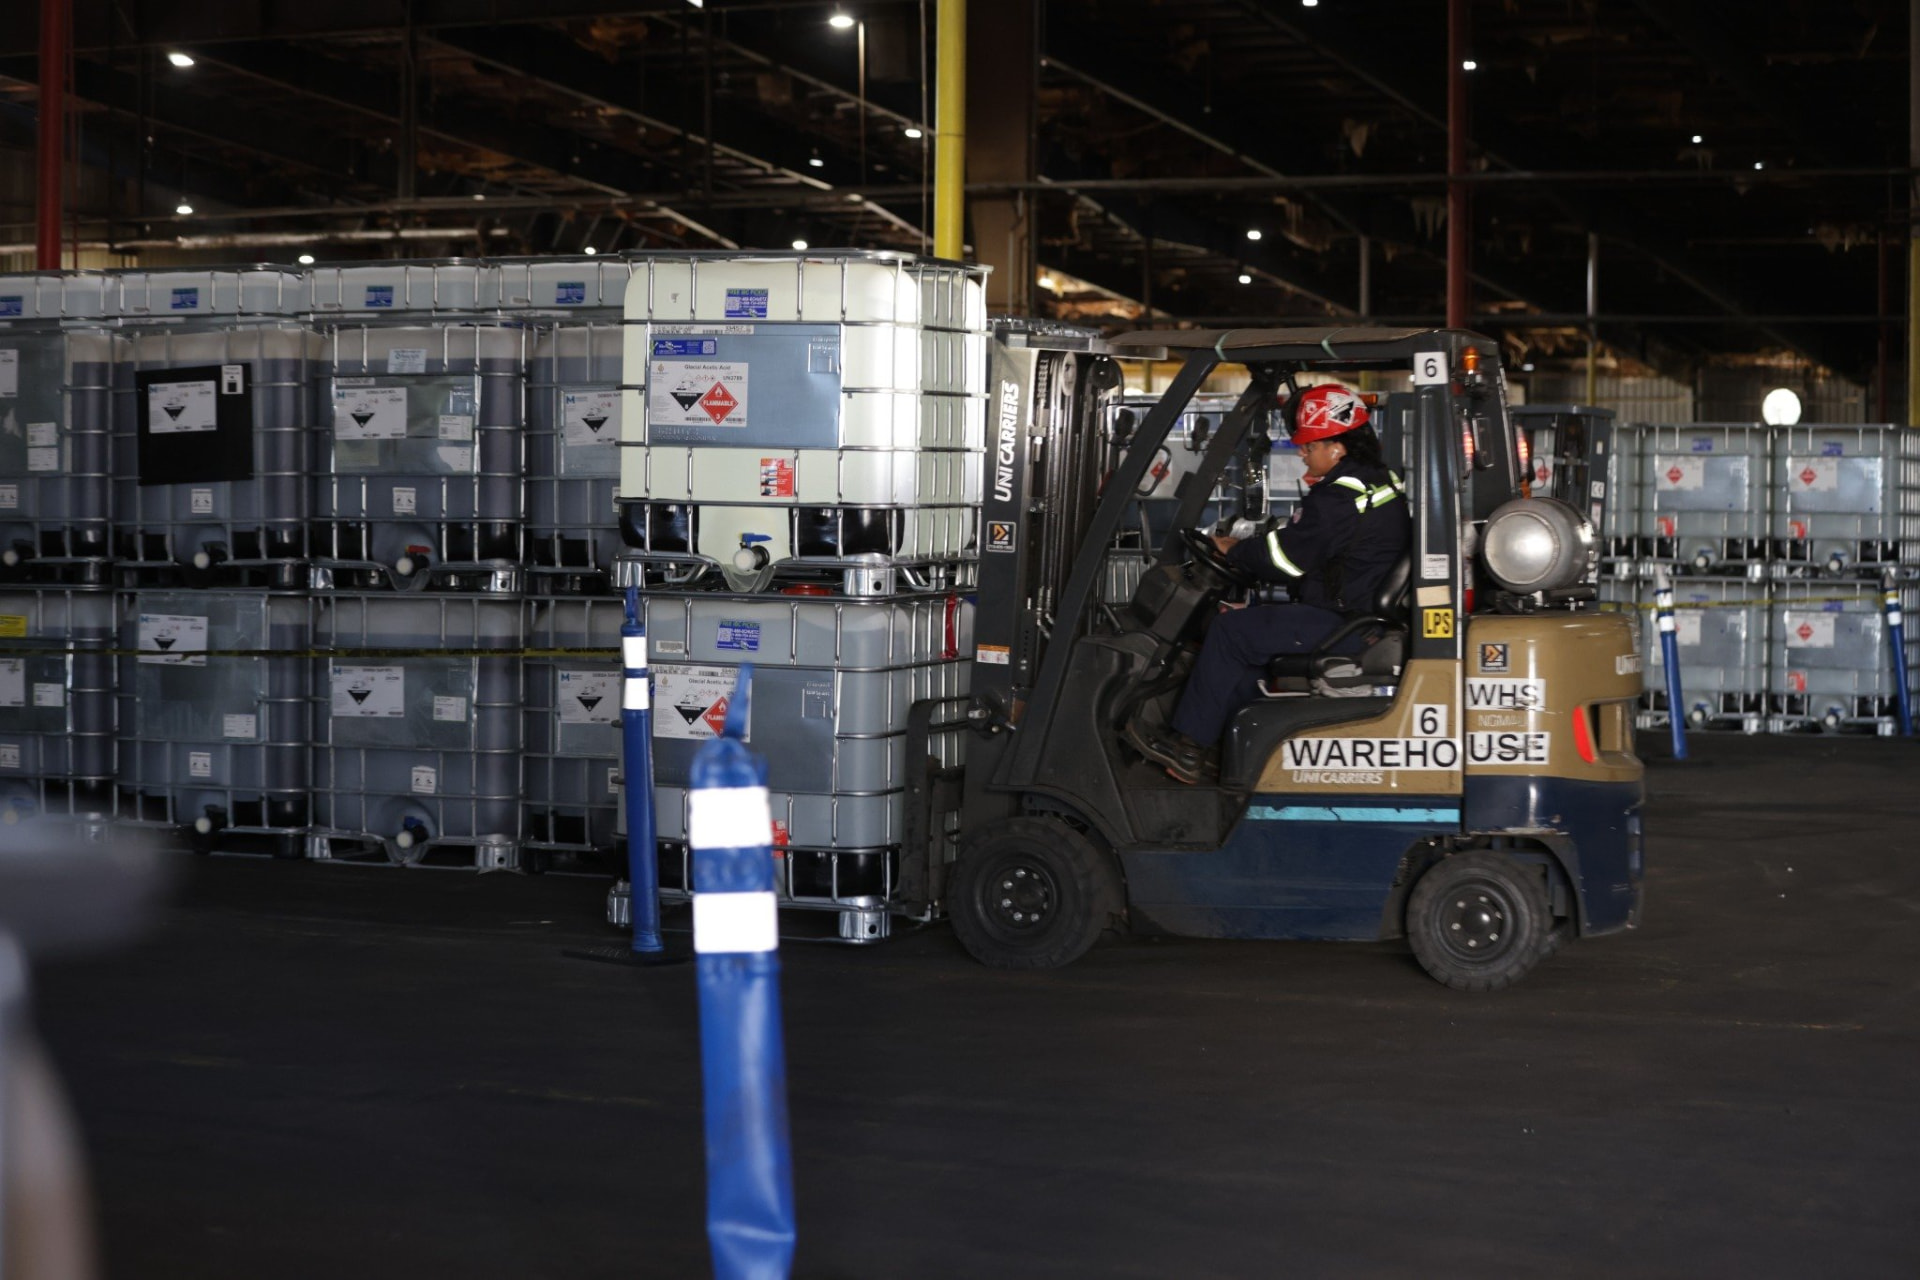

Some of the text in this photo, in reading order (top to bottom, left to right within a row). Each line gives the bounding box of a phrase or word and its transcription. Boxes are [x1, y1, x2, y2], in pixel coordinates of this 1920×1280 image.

[1424, 357, 1438, 378] 6
[703, 399, 735, 407] FLAMMABLE
[994, 380, 1019, 502] UNICARRIERS
[1424, 612, 1450, 635] LPS
[1469, 683, 1539, 707] WHS
[1420, 707, 1438, 735] 6
[1292, 769, 1384, 785] UNICARRIERS
